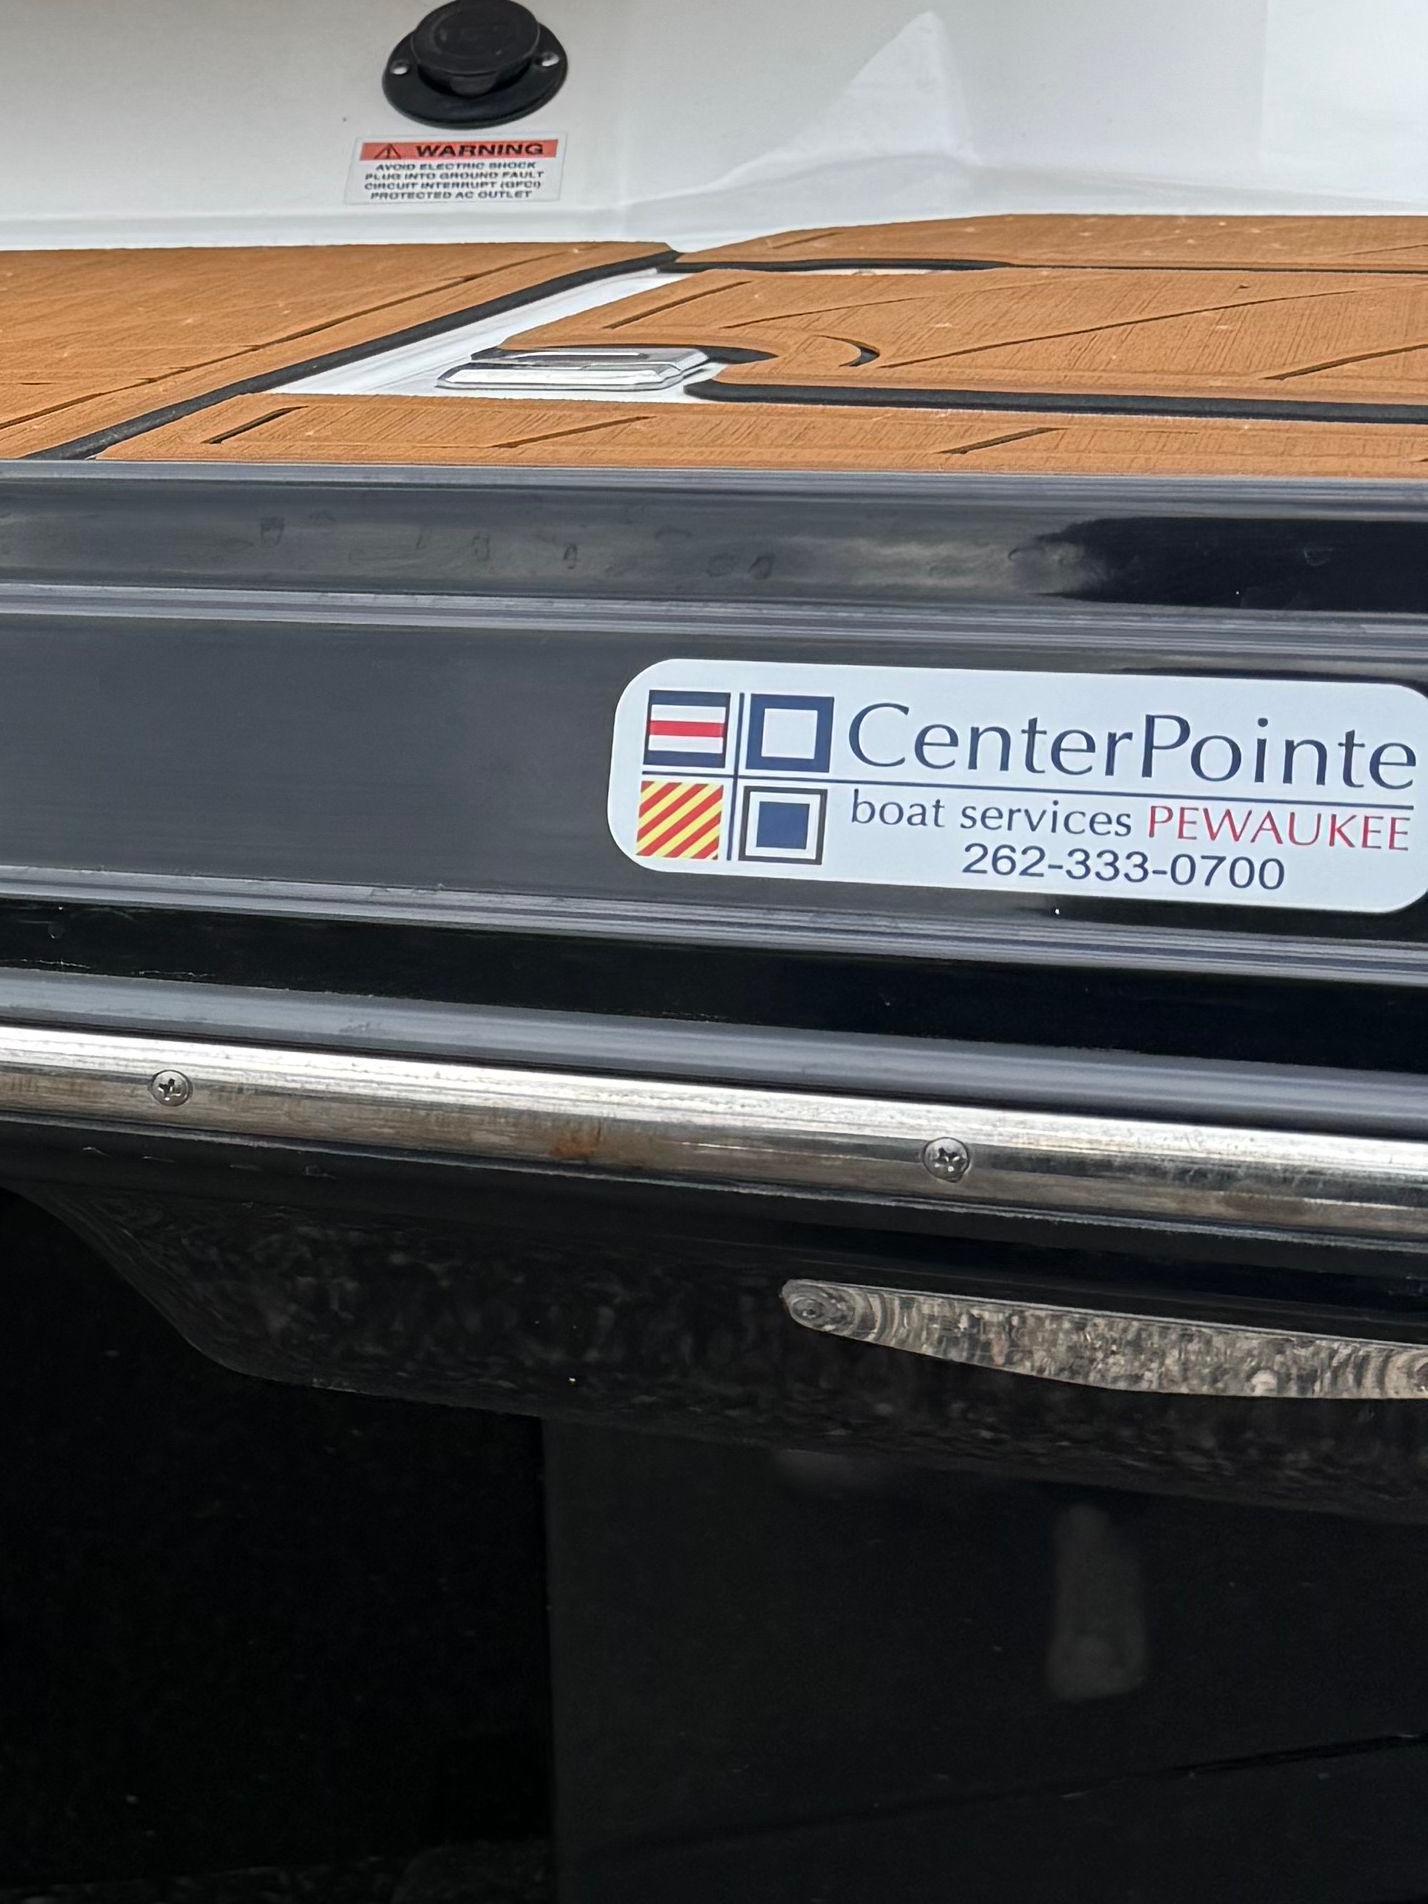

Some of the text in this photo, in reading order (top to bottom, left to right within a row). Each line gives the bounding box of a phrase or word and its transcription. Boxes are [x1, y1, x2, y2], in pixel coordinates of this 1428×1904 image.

[415, 143, 544, 158] WARNING
[375, 161, 536, 171] AVOID ELECTRIC SHOCK
[404, 172, 437, 180] INTO
[364, 181, 541, 190] CIRCUIT INTERRUPT (GFCI)
[370, 190, 532, 200] PROTECTED AC OUTLET
[848, 702, 1417, 790] CenterPointe
[851, 788, 1411, 851] boat services PEWAUKEE
[962, 842, 1285, 890] 262-333-0700
